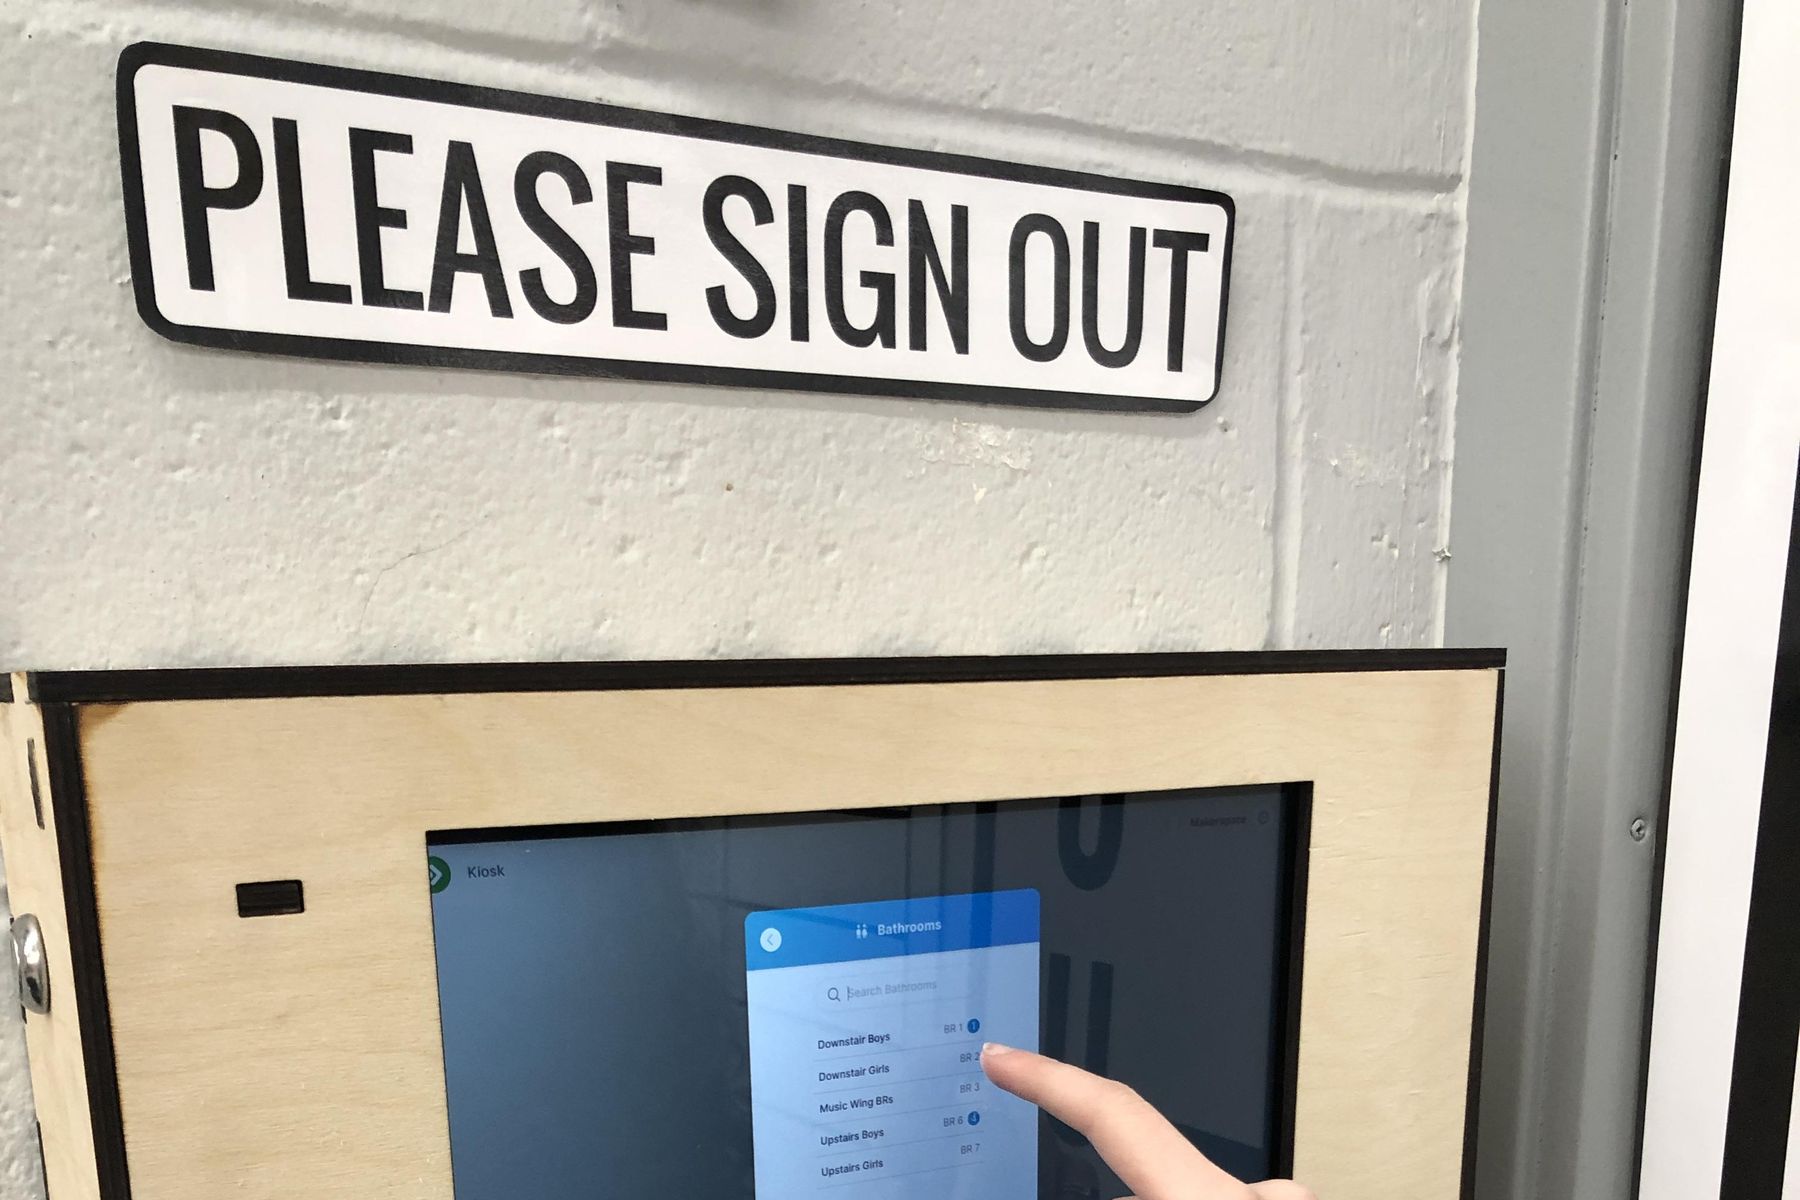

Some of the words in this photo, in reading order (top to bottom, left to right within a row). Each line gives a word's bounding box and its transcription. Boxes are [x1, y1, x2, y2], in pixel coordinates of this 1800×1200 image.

[171, 103, 668, 332] PLEASE
[702, 172, 969, 356] SIGN
[1009, 212, 1210, 373] OUT
[467, 865, 505, 878] Kiosk
[877, 919, 942, 937] Bathrooms
[848, 986, 882, 999] Search
[885, 980, 937, 995] Bathrooms
[944, 1024, 956, 1034] BR
[817, 1034, 865, 1050] Downstair
[867, 1032, 890, 1047] Boys
[960, 1053, 972, 1063] BR
[818, 1065, 866, 1082] Downstair
[869, 1063, 890, 1076] Girls
[960, 1084, 972, 1094] BR
[974, 1083, 980, 1092] 3
[819, 1100, 847, 1114] Music
[850, 1097, 874, 1112] Wing
[876, 1095, 893, 1108] BRs
[943, 1117, 956, 1128] BR
[820, 1131, 860, 1147] Upstairs
[862, 1127, 884, 1142] Boys
[960, 1145, 973, 1154] BR
[975, 1143, 980, 1152] 7
[821, 1161, 860, 1177] Upstairs
[863, 1158, 884, 1172] Girls
